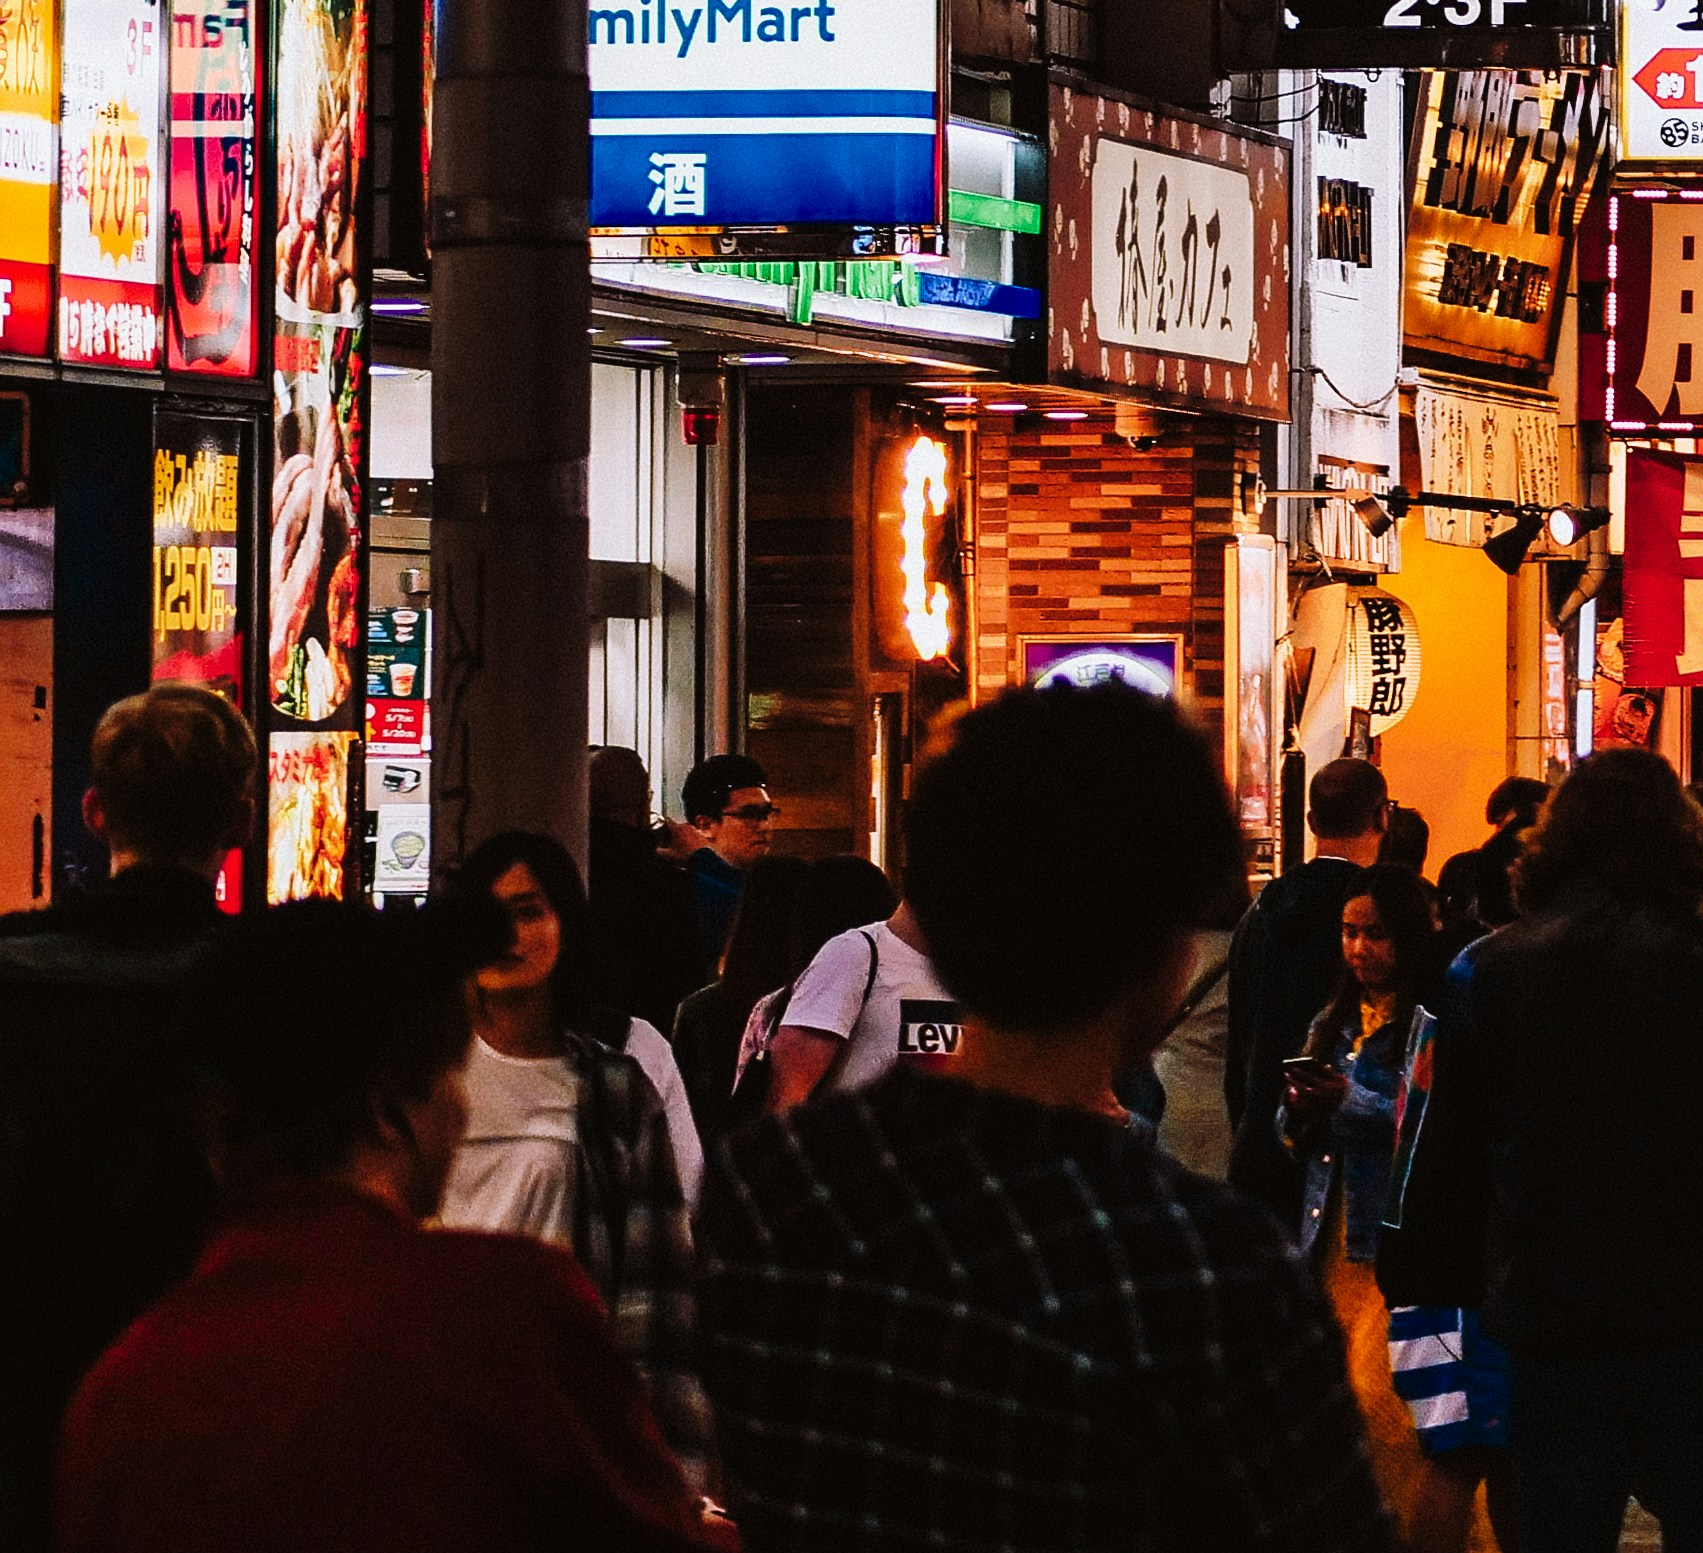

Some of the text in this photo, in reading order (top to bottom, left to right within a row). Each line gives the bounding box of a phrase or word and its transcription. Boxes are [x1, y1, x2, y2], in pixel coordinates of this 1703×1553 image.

[647, 152, 707, 217] 酒
[1114, 157, 1235, 336] 椿屋カフェ
[152, 448, 238, 533] 飲み放題
[1367, 596, 1406, 717] 豚野郎
